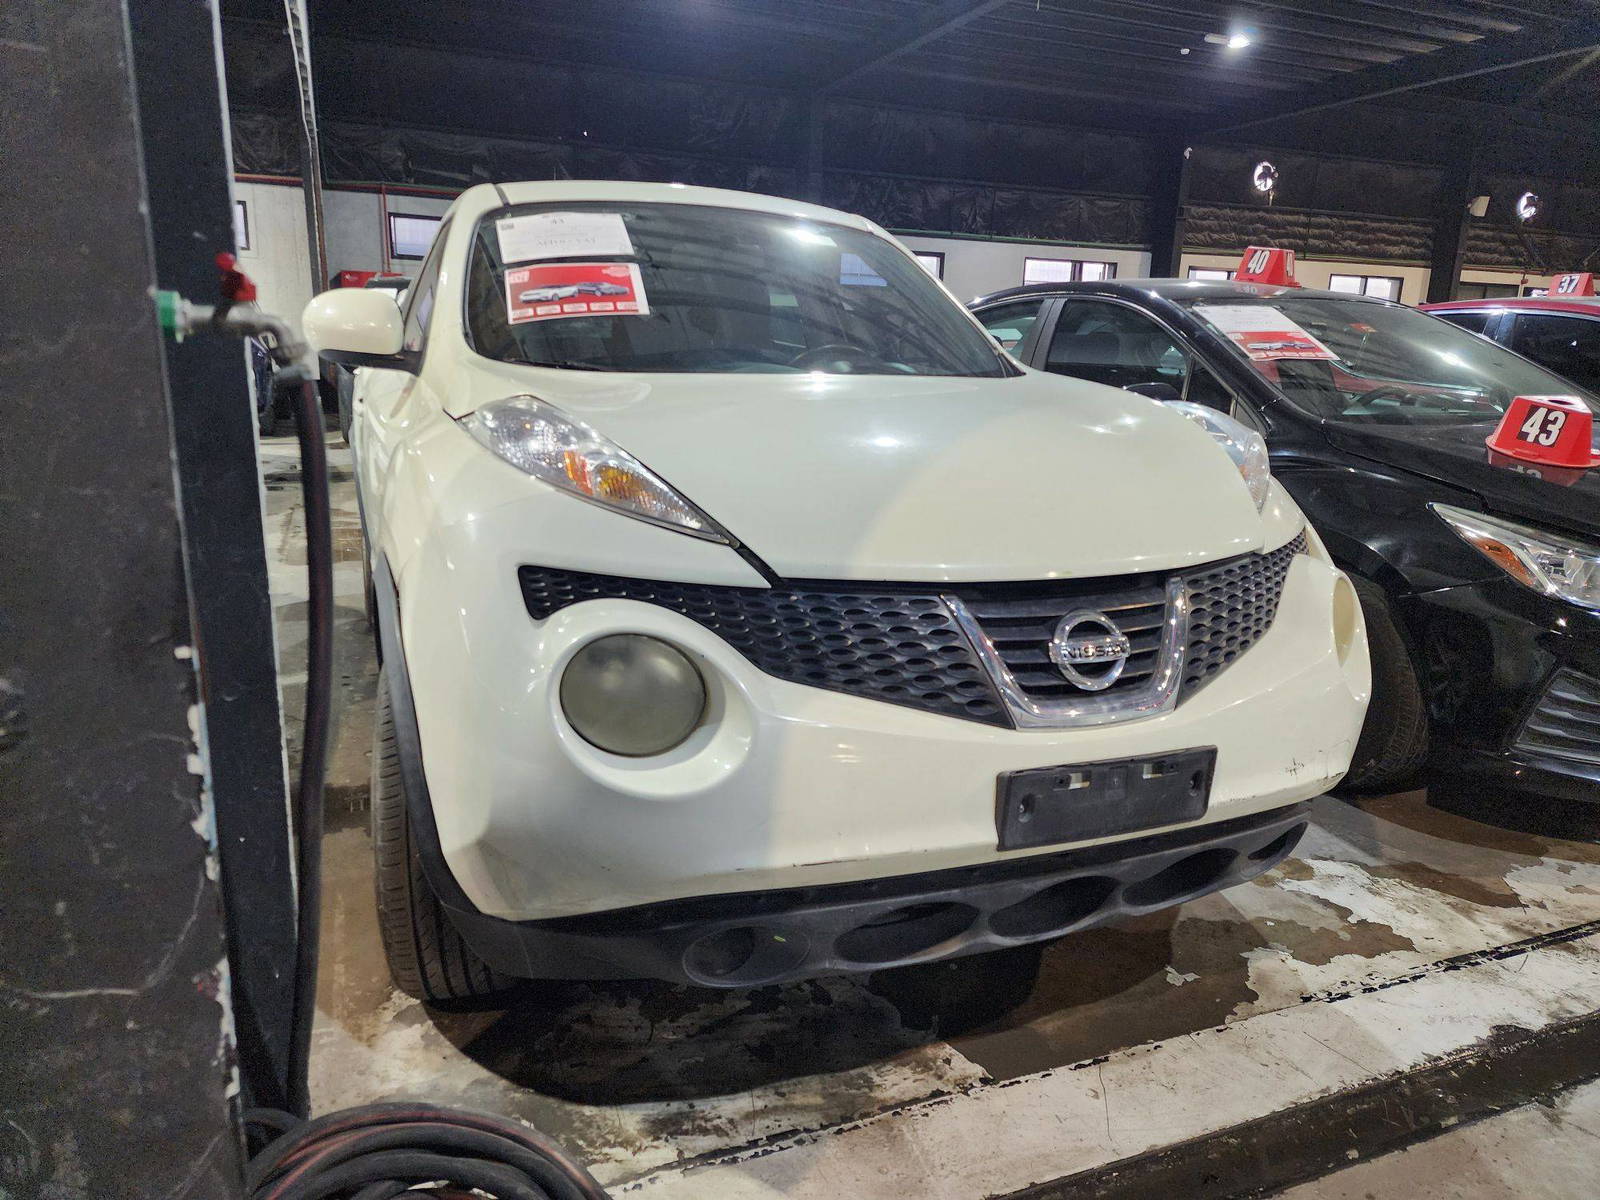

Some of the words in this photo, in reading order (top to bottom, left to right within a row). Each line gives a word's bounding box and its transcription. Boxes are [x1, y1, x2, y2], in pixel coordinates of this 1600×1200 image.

[1247, 250, 1270, 274] 40
[1557, 275, 1581, 294] 37
[1521, 407, 1566, 446] 43
